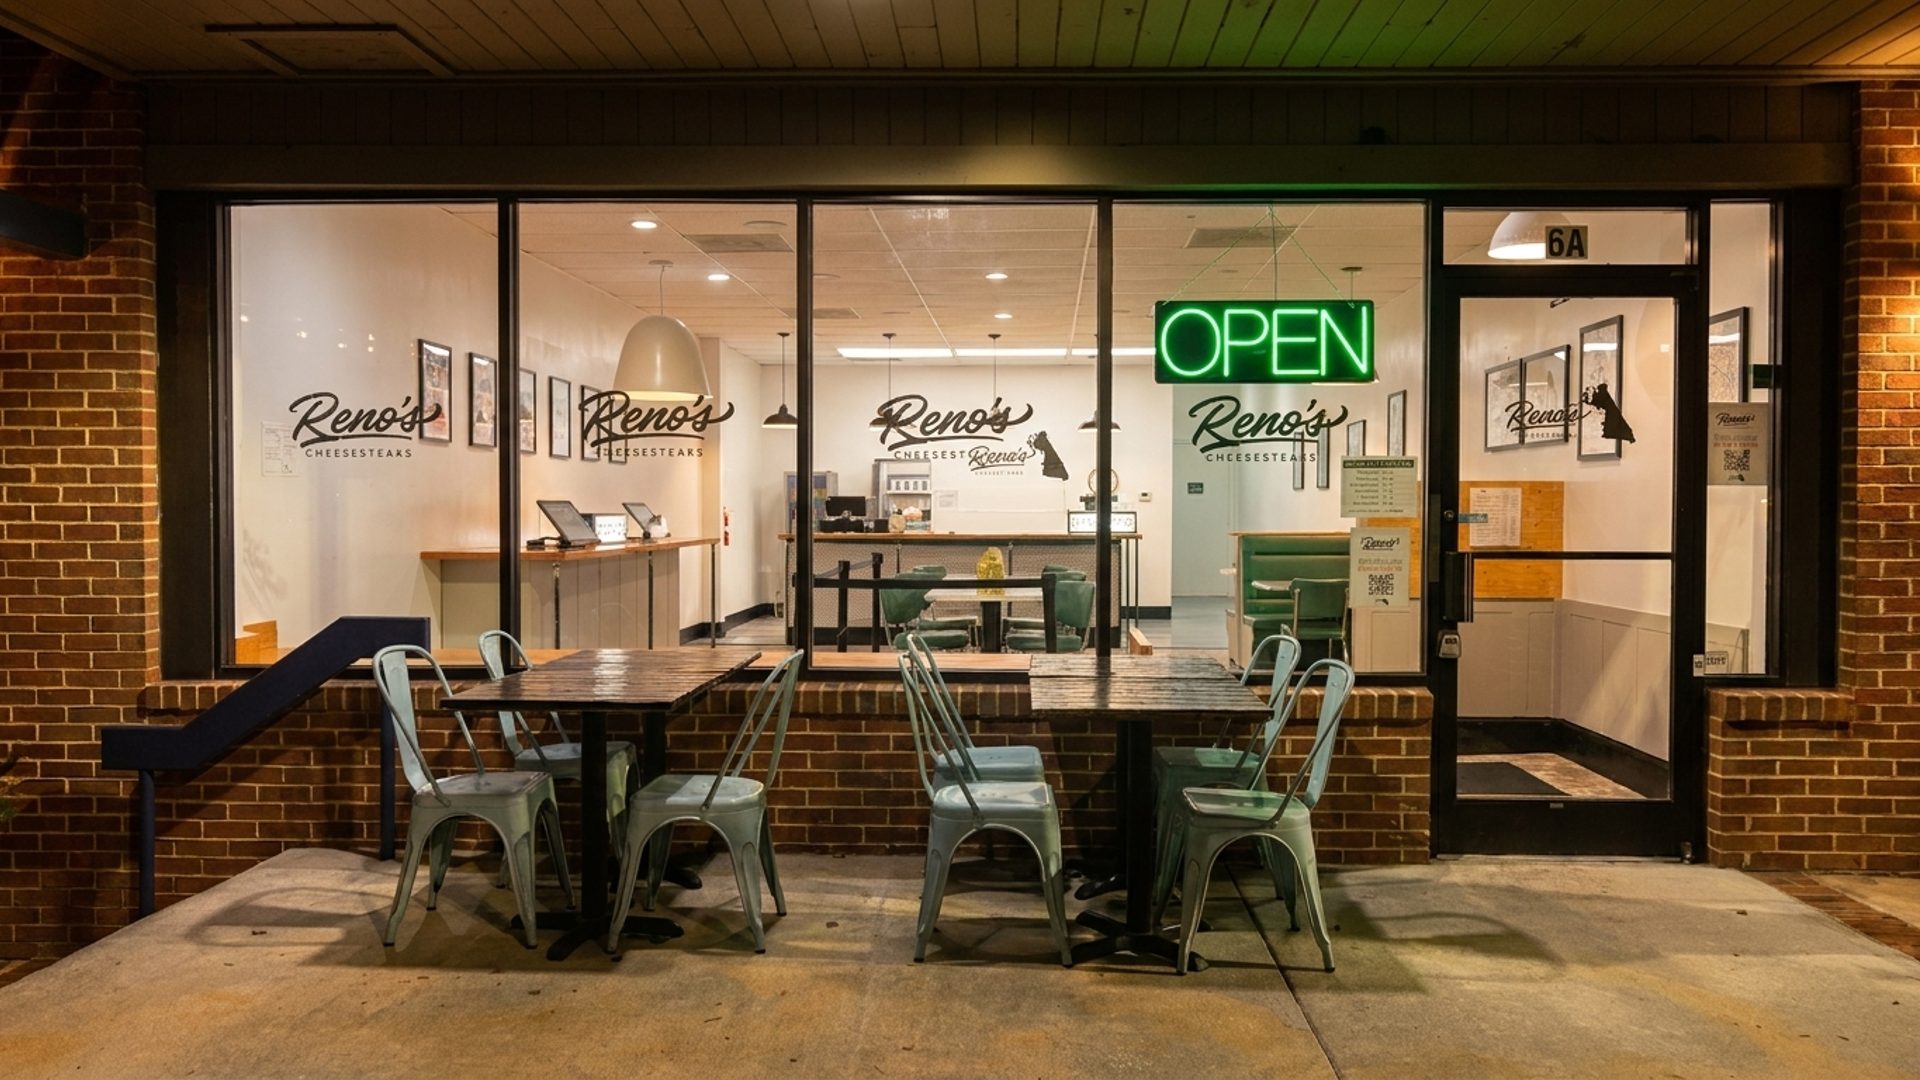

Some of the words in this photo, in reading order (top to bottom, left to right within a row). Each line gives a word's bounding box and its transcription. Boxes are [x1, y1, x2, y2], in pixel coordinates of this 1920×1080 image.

[1549, 228, 1585, 257] 6A
[1160, 306, 1369, 378] OPEN
[289, 391, 442, 448] Reno's
[578, 390, 735, 448] Reno's
[877, 394, 1033, 452] Reno's
[1188, 396, 1348, 454] Reno's
[305, 448, 412, 458] CHEESESTEAKS
